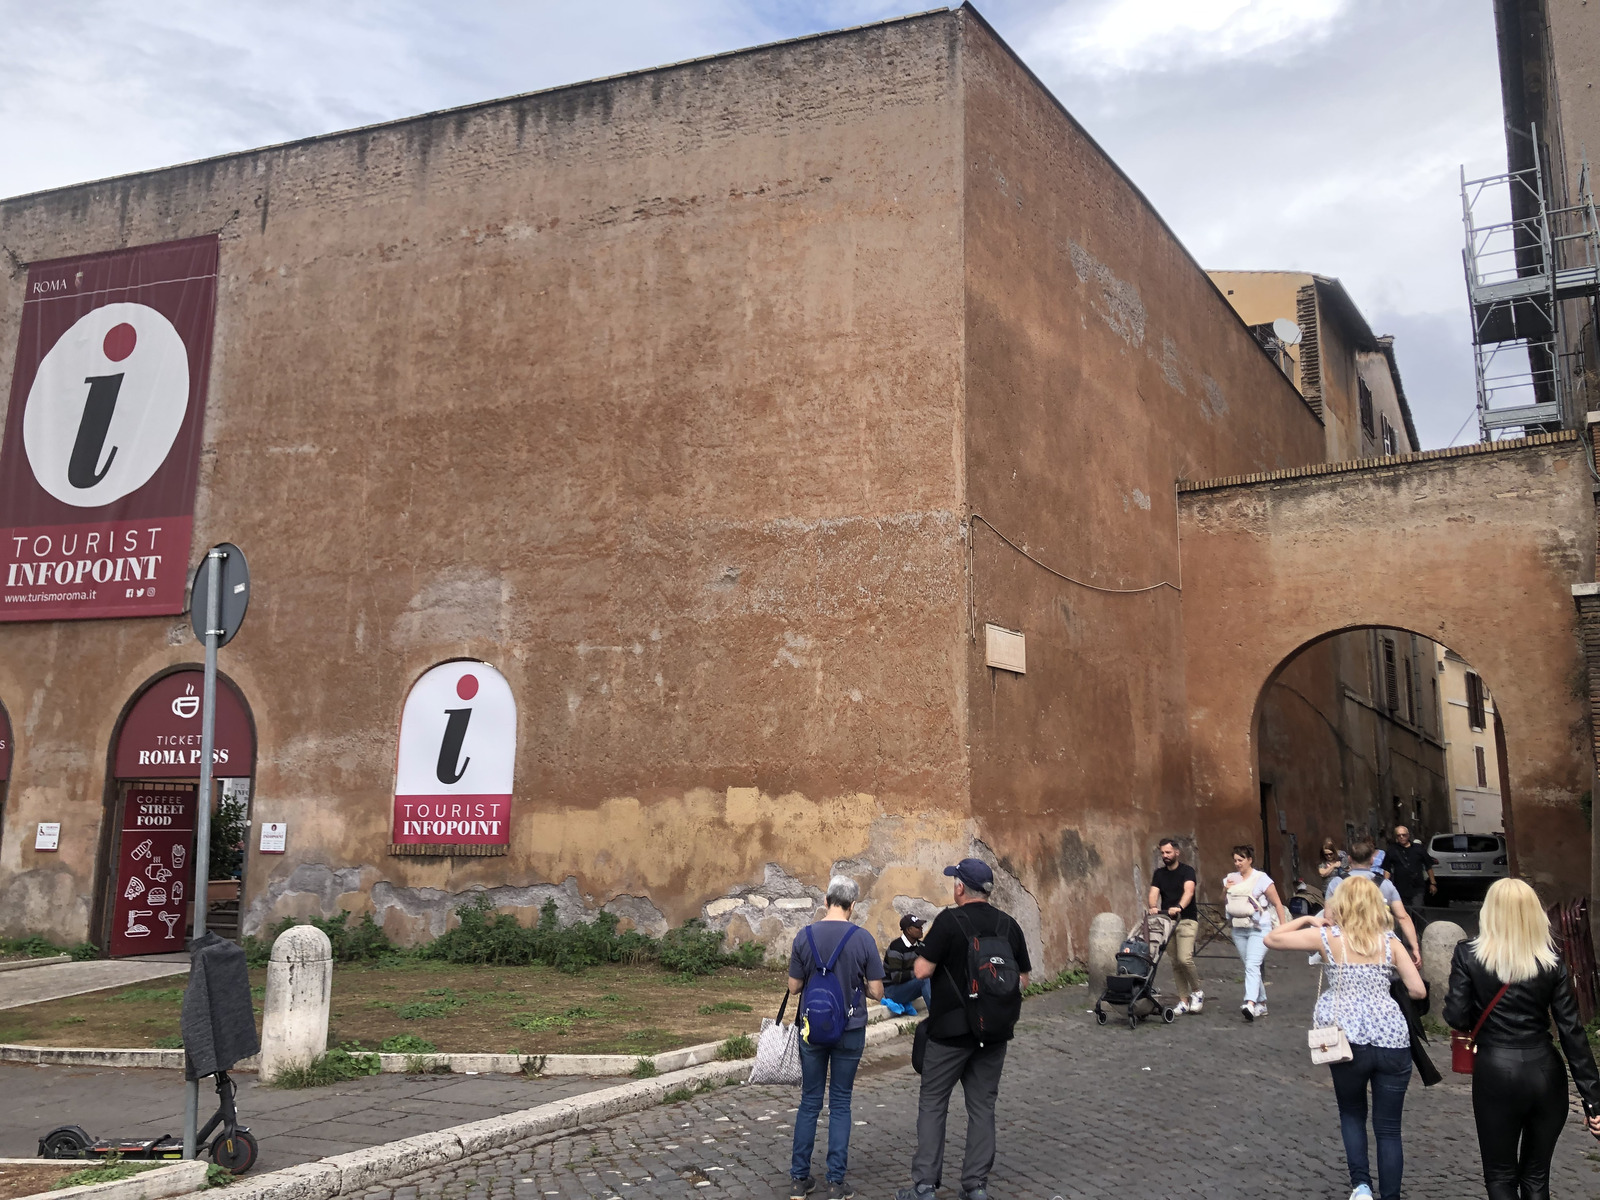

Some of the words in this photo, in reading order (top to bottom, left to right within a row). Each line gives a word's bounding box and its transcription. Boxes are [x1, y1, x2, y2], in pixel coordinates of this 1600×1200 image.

[33, 278, 67, 294] ROMA
[67, 322, 137, 489] i
[13, 527, 162, 558] TOURIST
[5, 555, 162, 587] INFOPOINT
[4, 589, 97, 603] www.turismoroma.it
[436, 673, 479, 785] i
[138, 749, 186, 765] ROMA
[189, 748, 229, 764] PSS
[136, 795, 182, 804] COFFEE
[139, 804, 185, 815] STREET
[403, 803, 501, 818] TOURIST
[137, 815, 172, 826] FOOD
[402, 820, 501, 836] INFOPOINT
